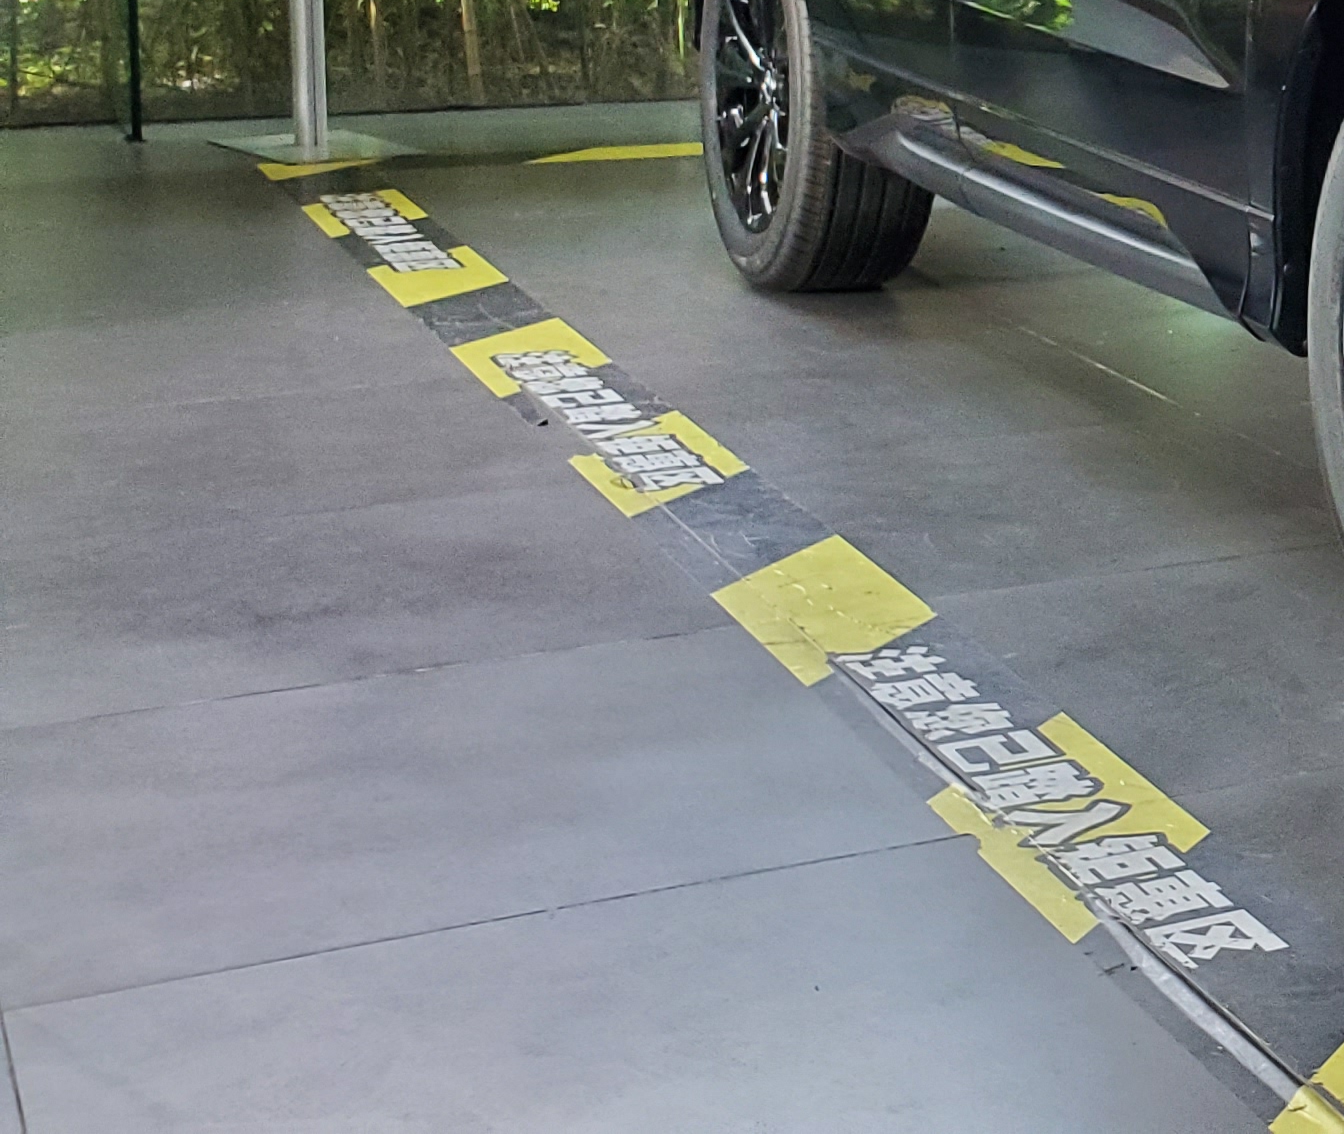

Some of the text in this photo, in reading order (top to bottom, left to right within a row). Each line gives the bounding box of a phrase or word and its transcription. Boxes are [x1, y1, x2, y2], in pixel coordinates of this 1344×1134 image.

[831, 645, 1290, 969] 注意您已踏入钜惠区
